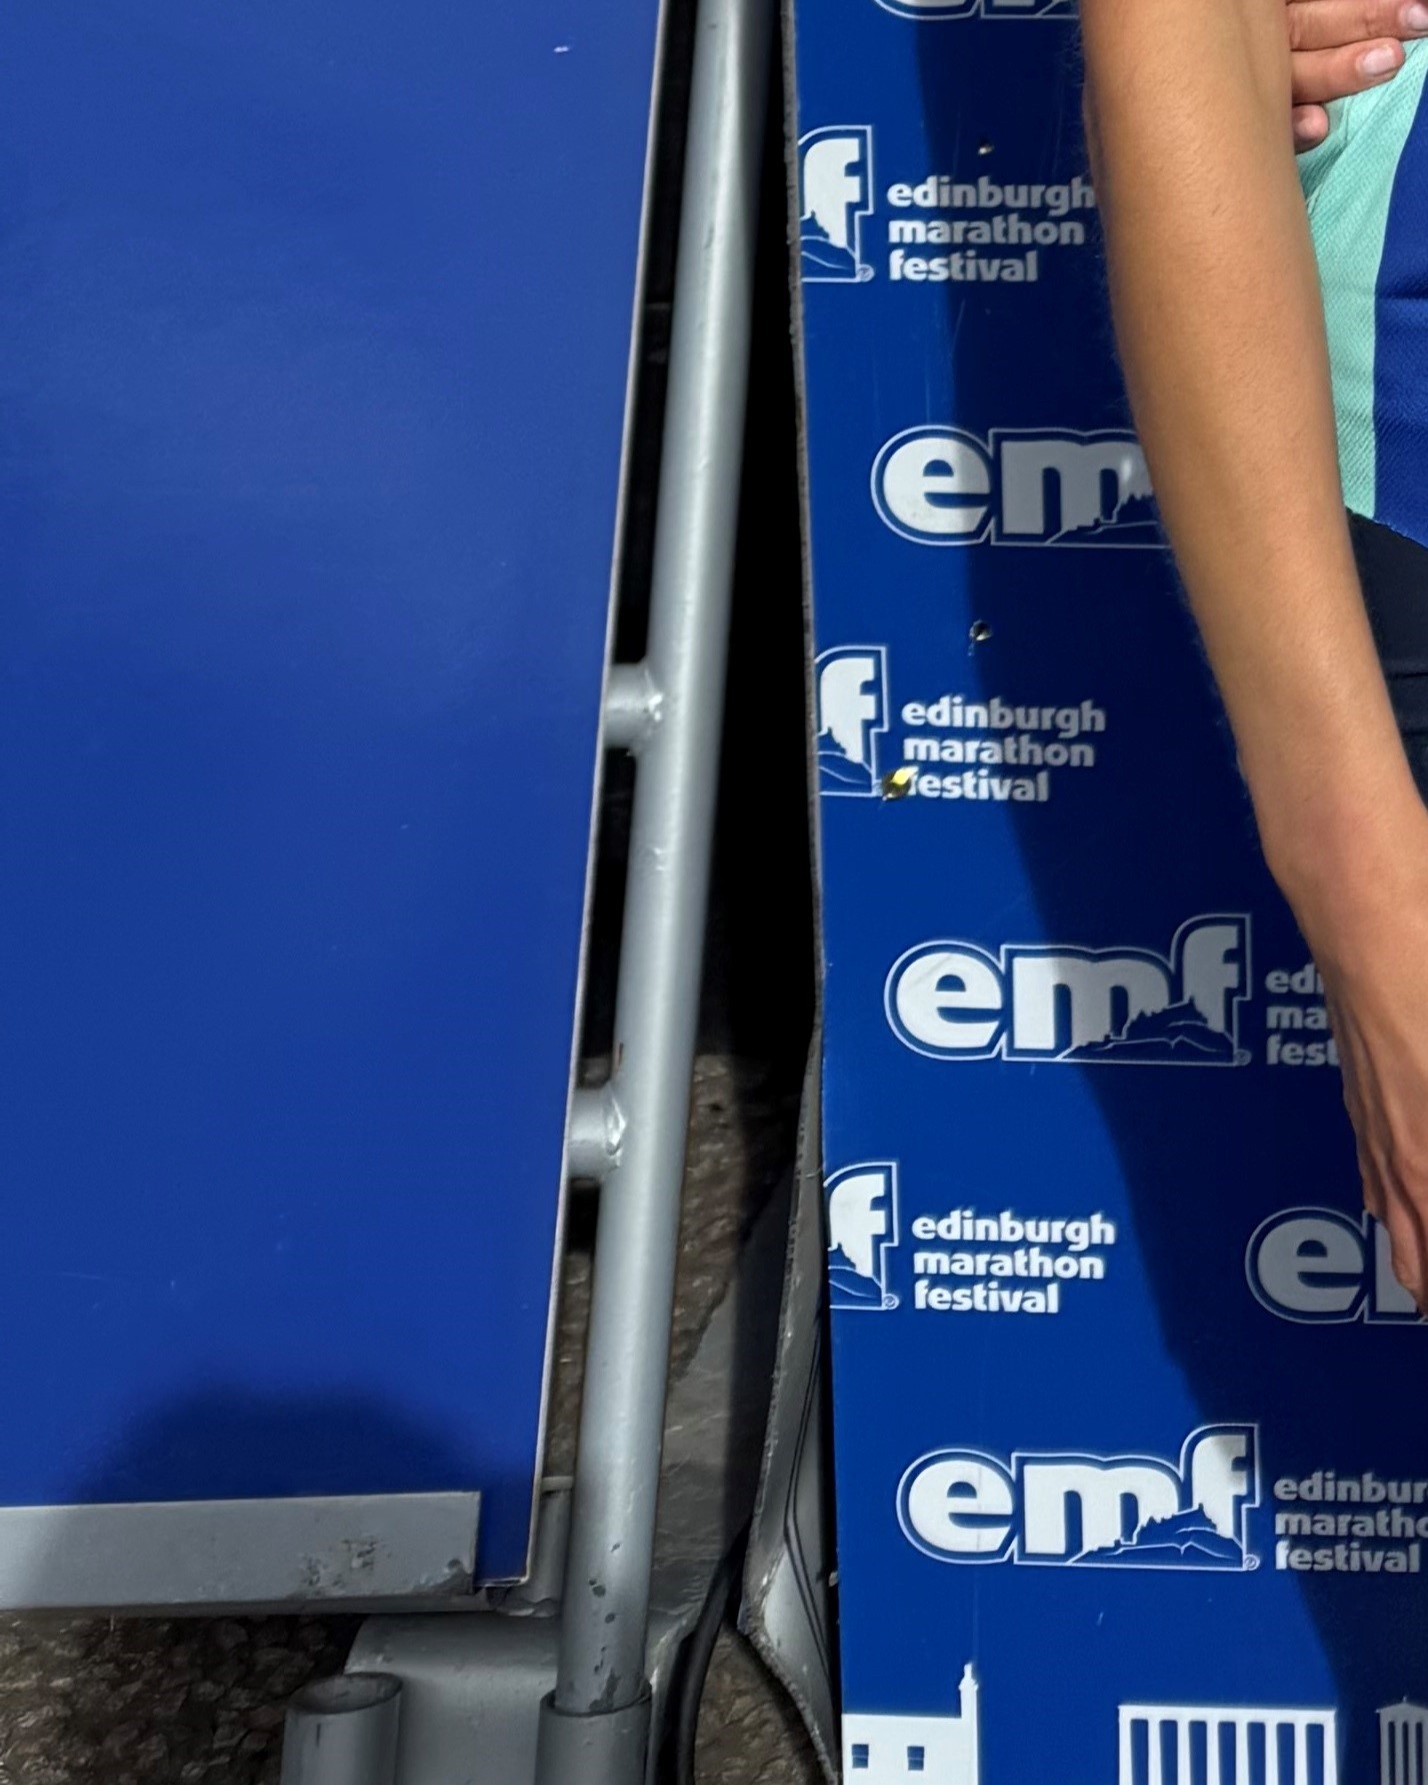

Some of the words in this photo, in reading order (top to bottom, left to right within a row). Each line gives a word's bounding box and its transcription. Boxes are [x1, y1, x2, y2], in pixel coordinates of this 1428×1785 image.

[911, 1209, 1116, 1252] edinburgh
[913, 1246, 1105, 1280] marathon
[914, 1278, 1059, 1314] festival
[903, 1431, 1253, 1564] emf
